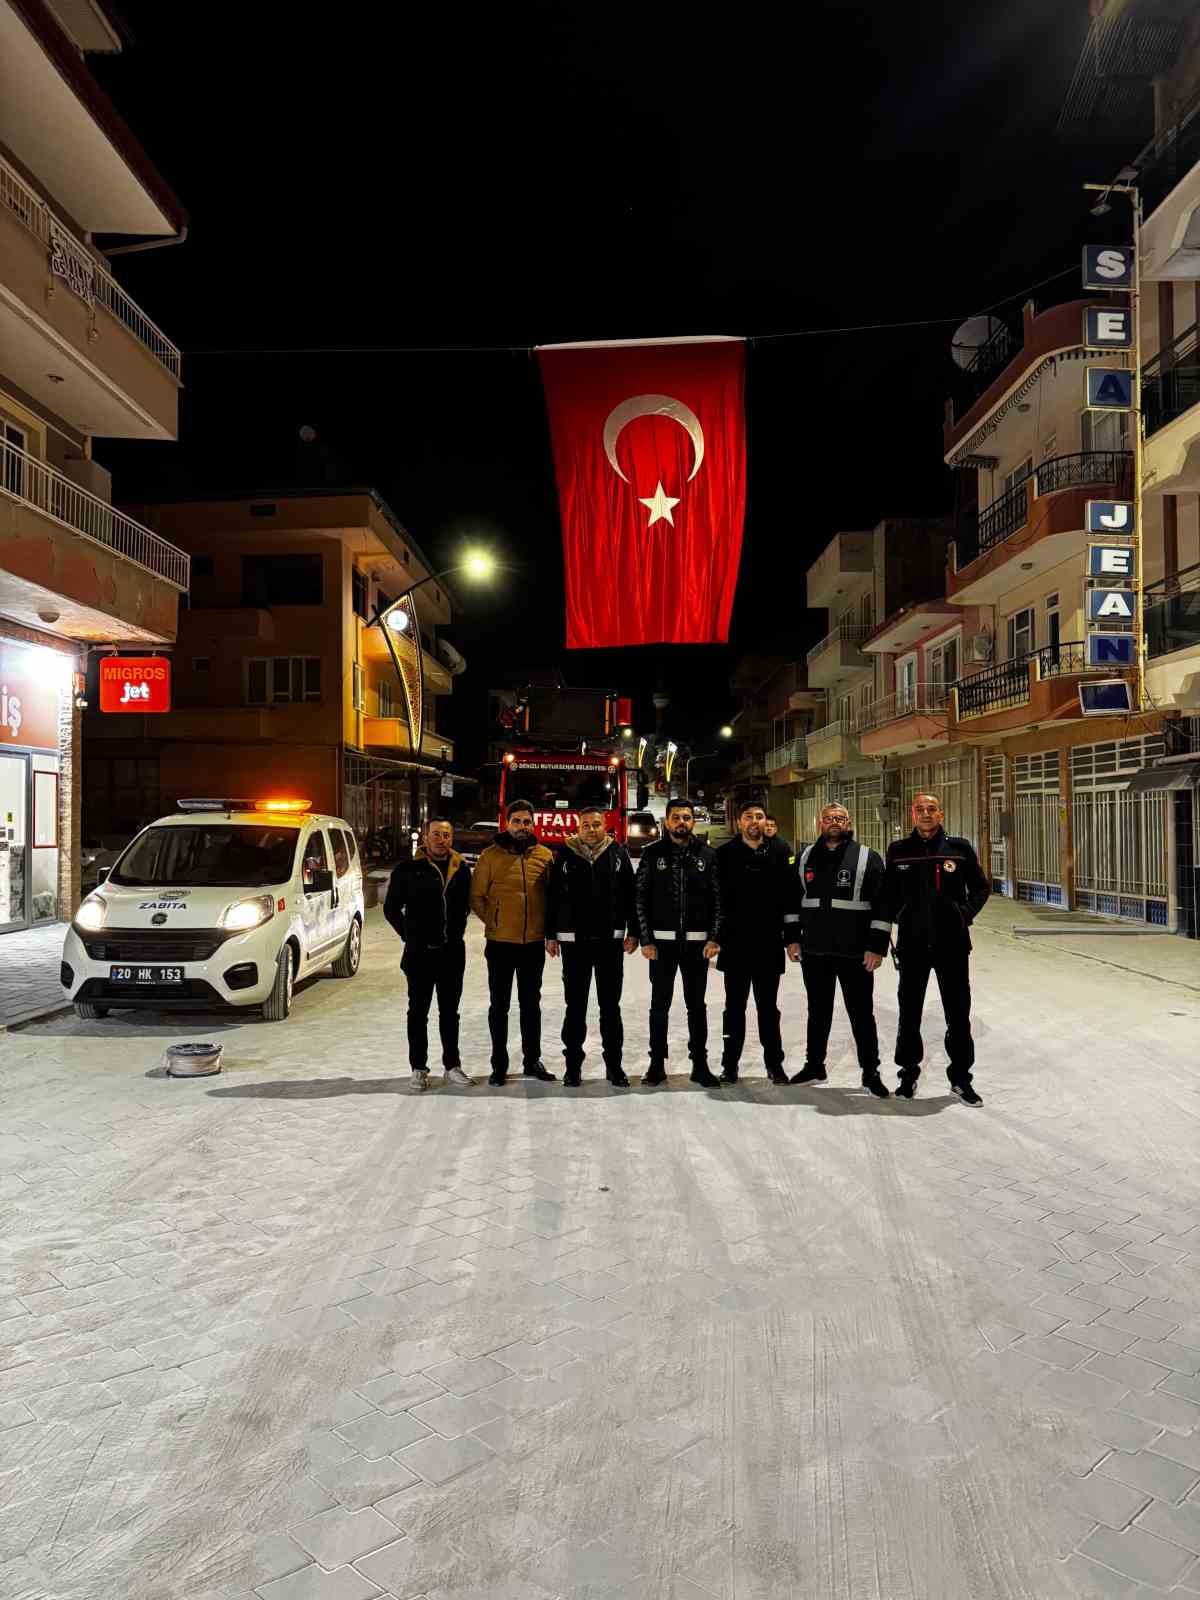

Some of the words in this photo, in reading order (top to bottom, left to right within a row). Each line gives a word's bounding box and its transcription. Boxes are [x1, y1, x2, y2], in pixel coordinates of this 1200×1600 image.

[1094, 250, 1130, 404] SEA
[1097, 503, 1132, 664] JEAN
[104, 667, 166, 680] MIGROS
[119, 681, 150, 703] jet
[117, 968, 131, 979] 20
[138, 968, 152, 980] HK
[160, 968, 182, 980] 153
